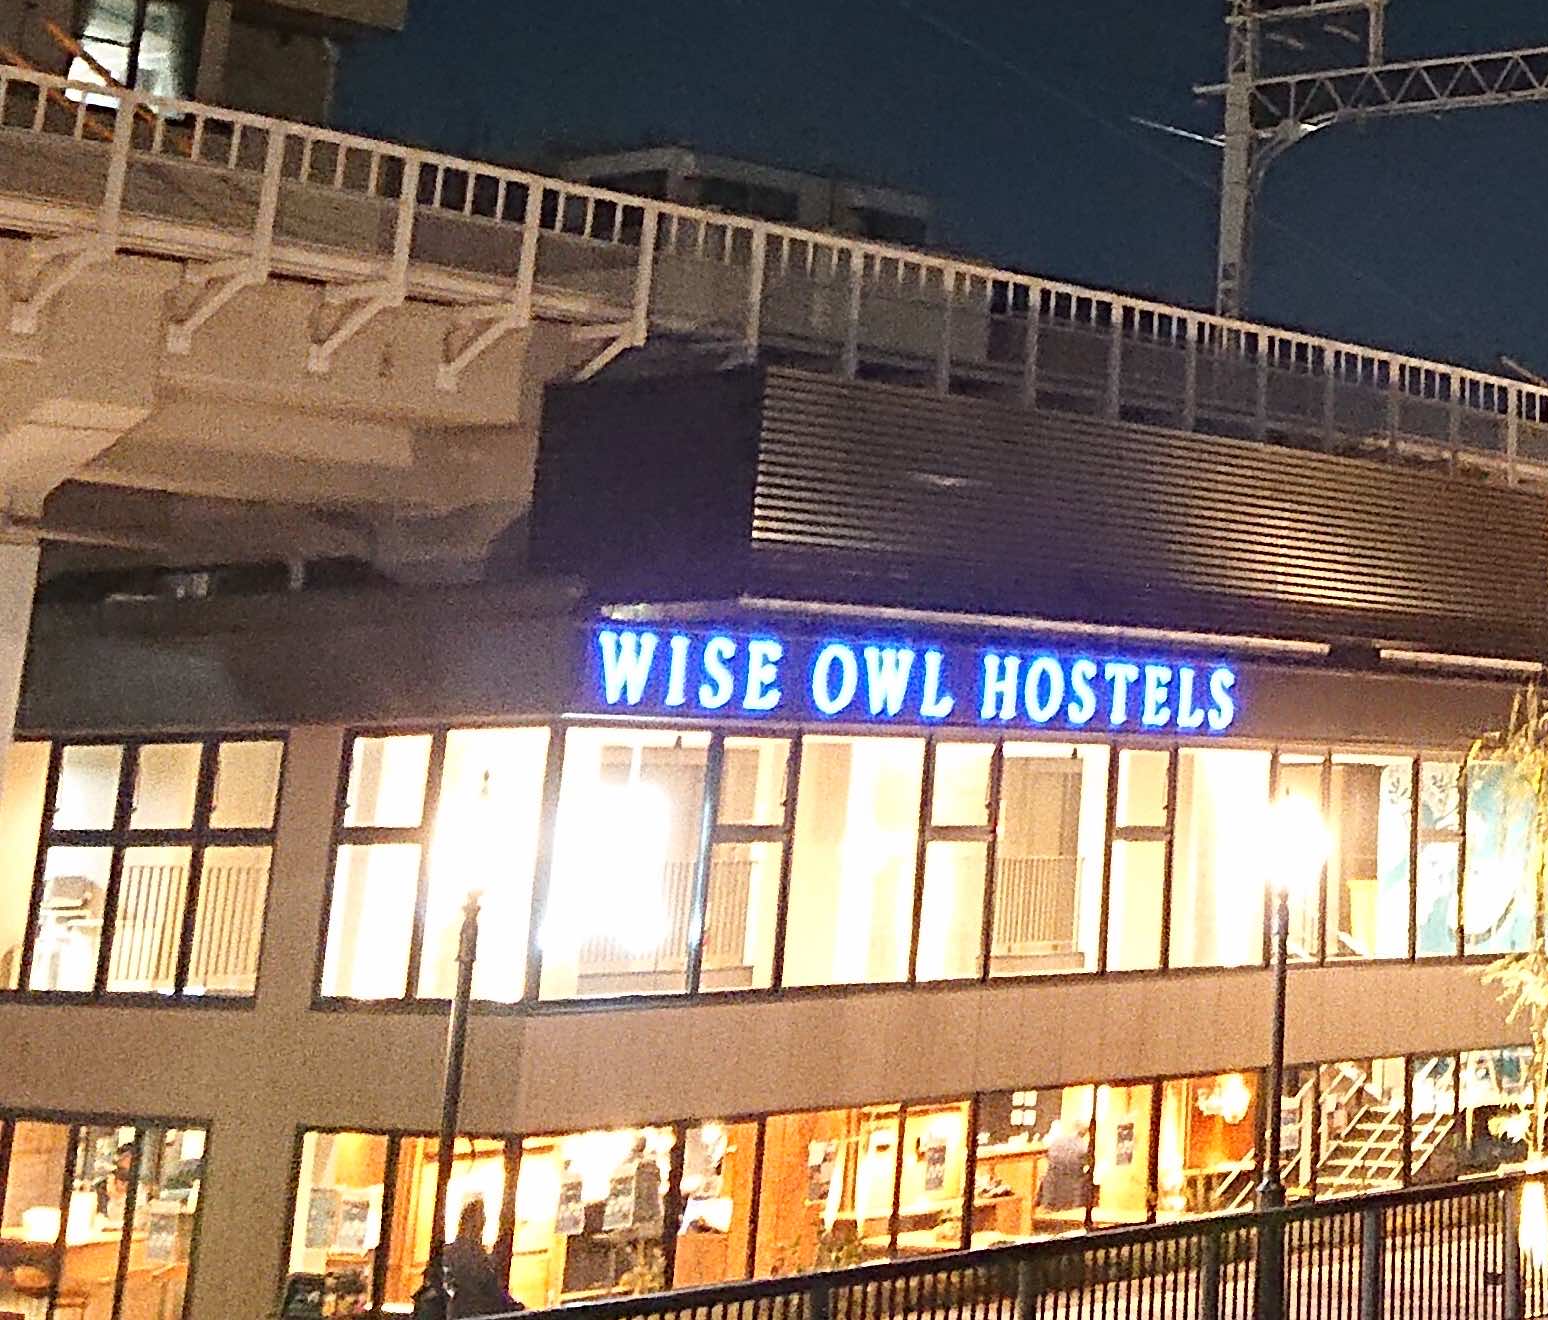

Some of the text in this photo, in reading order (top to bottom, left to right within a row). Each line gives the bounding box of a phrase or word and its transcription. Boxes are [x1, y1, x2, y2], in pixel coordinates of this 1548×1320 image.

[598, 630, 1236, 731] WISE OWL HOSTELS
